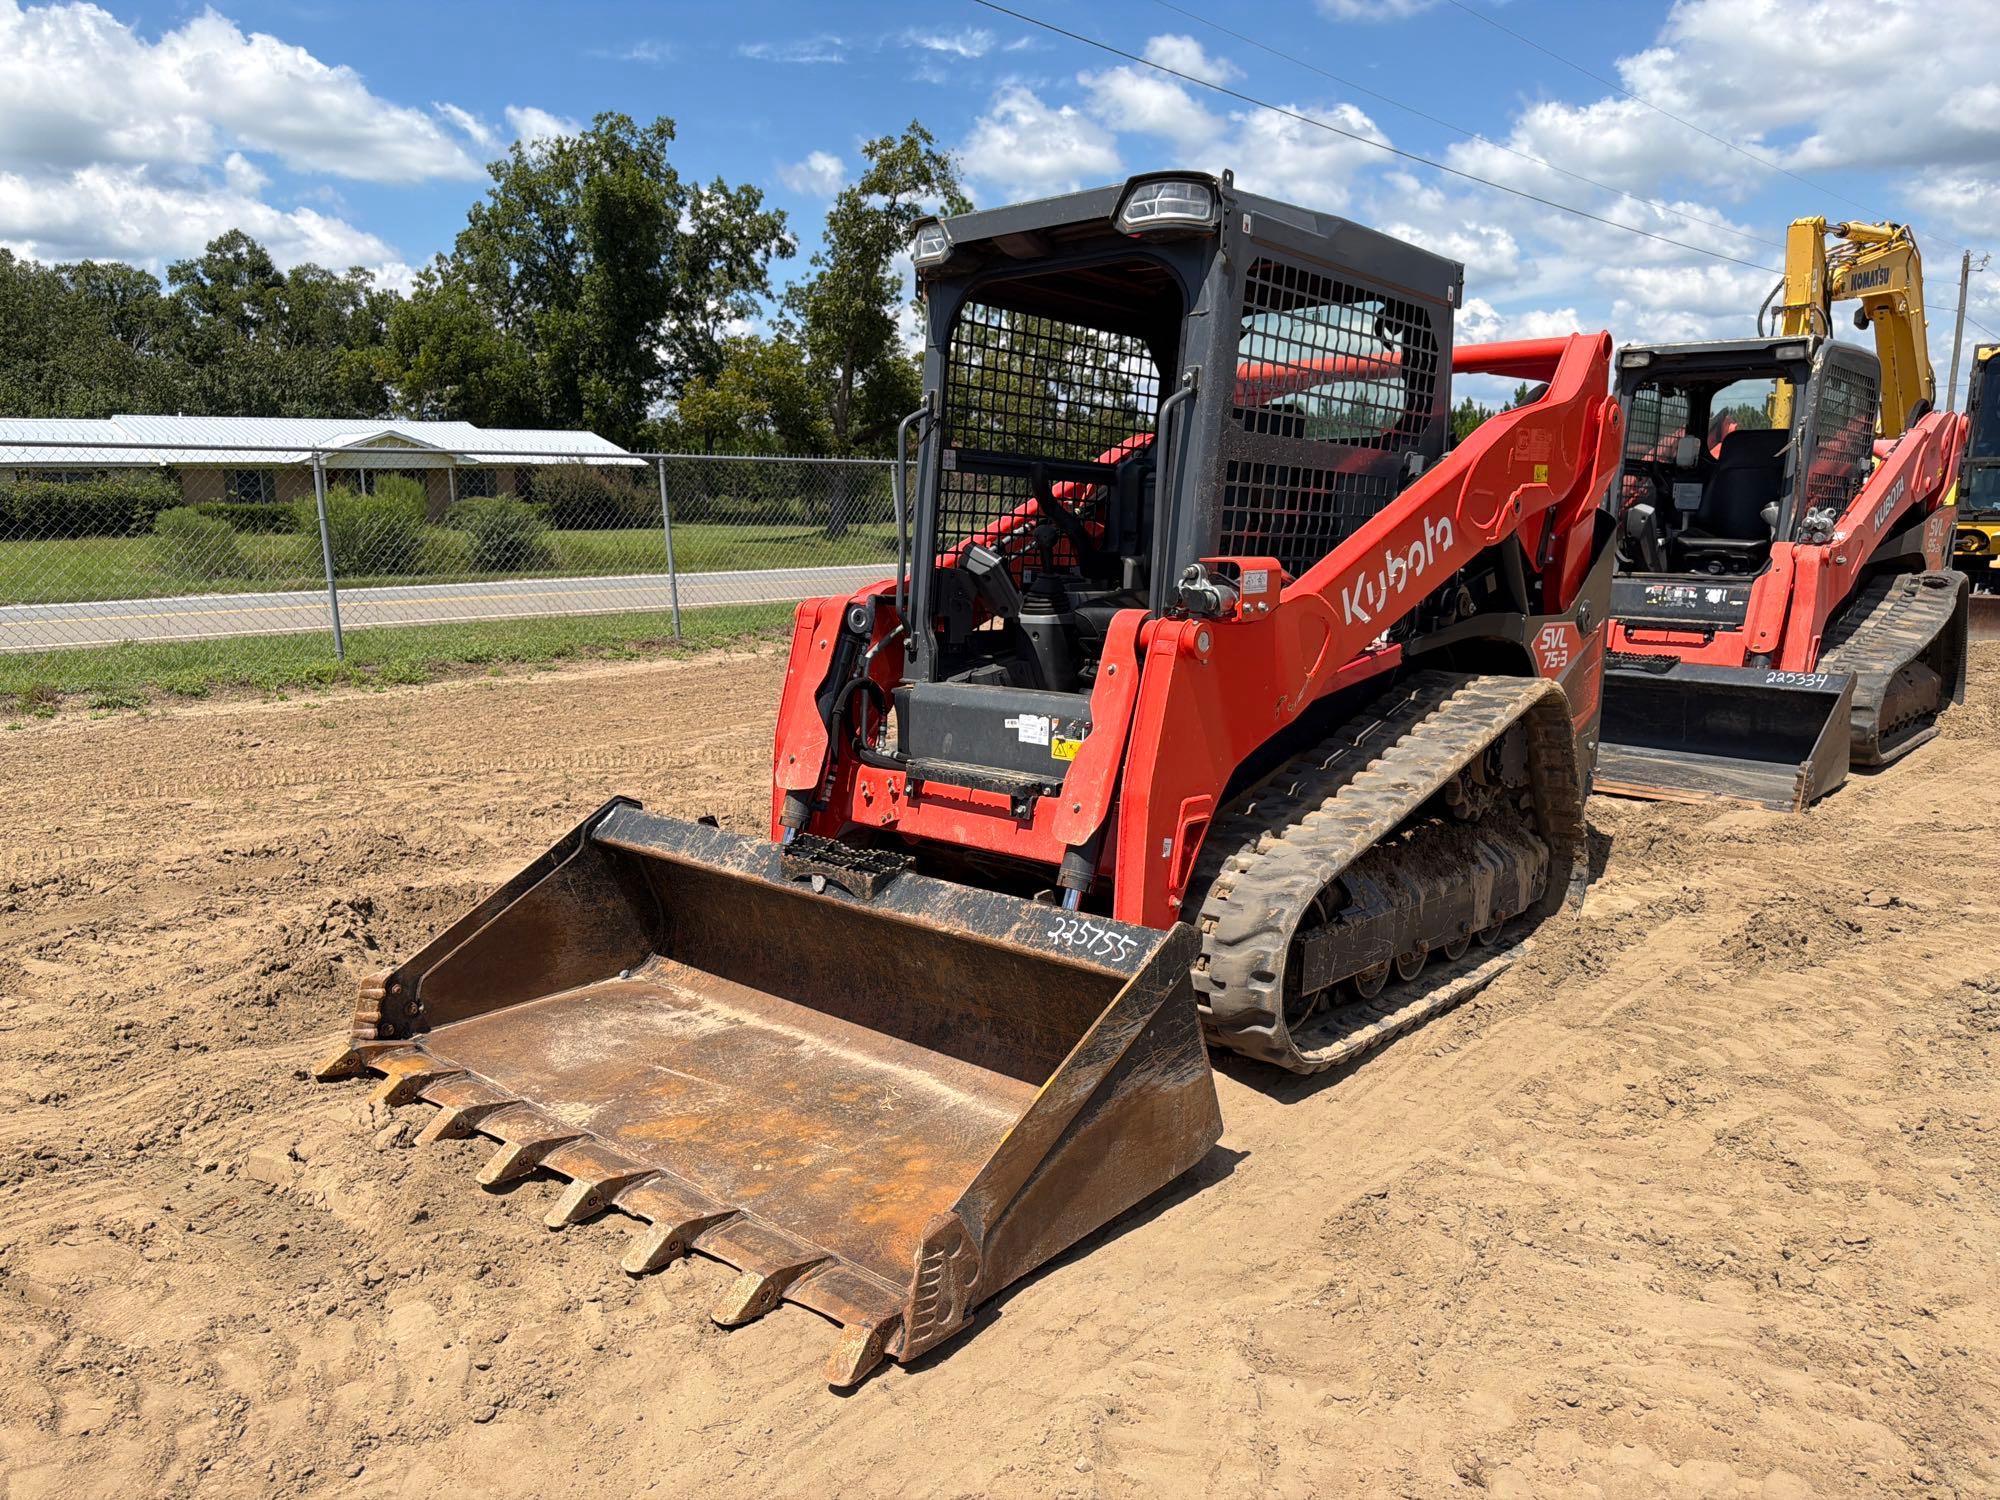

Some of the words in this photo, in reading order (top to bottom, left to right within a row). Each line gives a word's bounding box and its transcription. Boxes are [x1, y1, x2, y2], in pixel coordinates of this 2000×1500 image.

[1851, 264, 1889, 291] KOMATSU
[1874, 475, 1905, 533] KUBOTA
[1929, 518, 1944, 537] SVL
[1341, 516, 1454, 626] Kubota
[1539, 627, 1568, 650] SVL
[1543, 650, 1568, 669] 75-3
[1765, 671, 1829, 689] 225334
[1047, 917, 1138, 962] 225755
